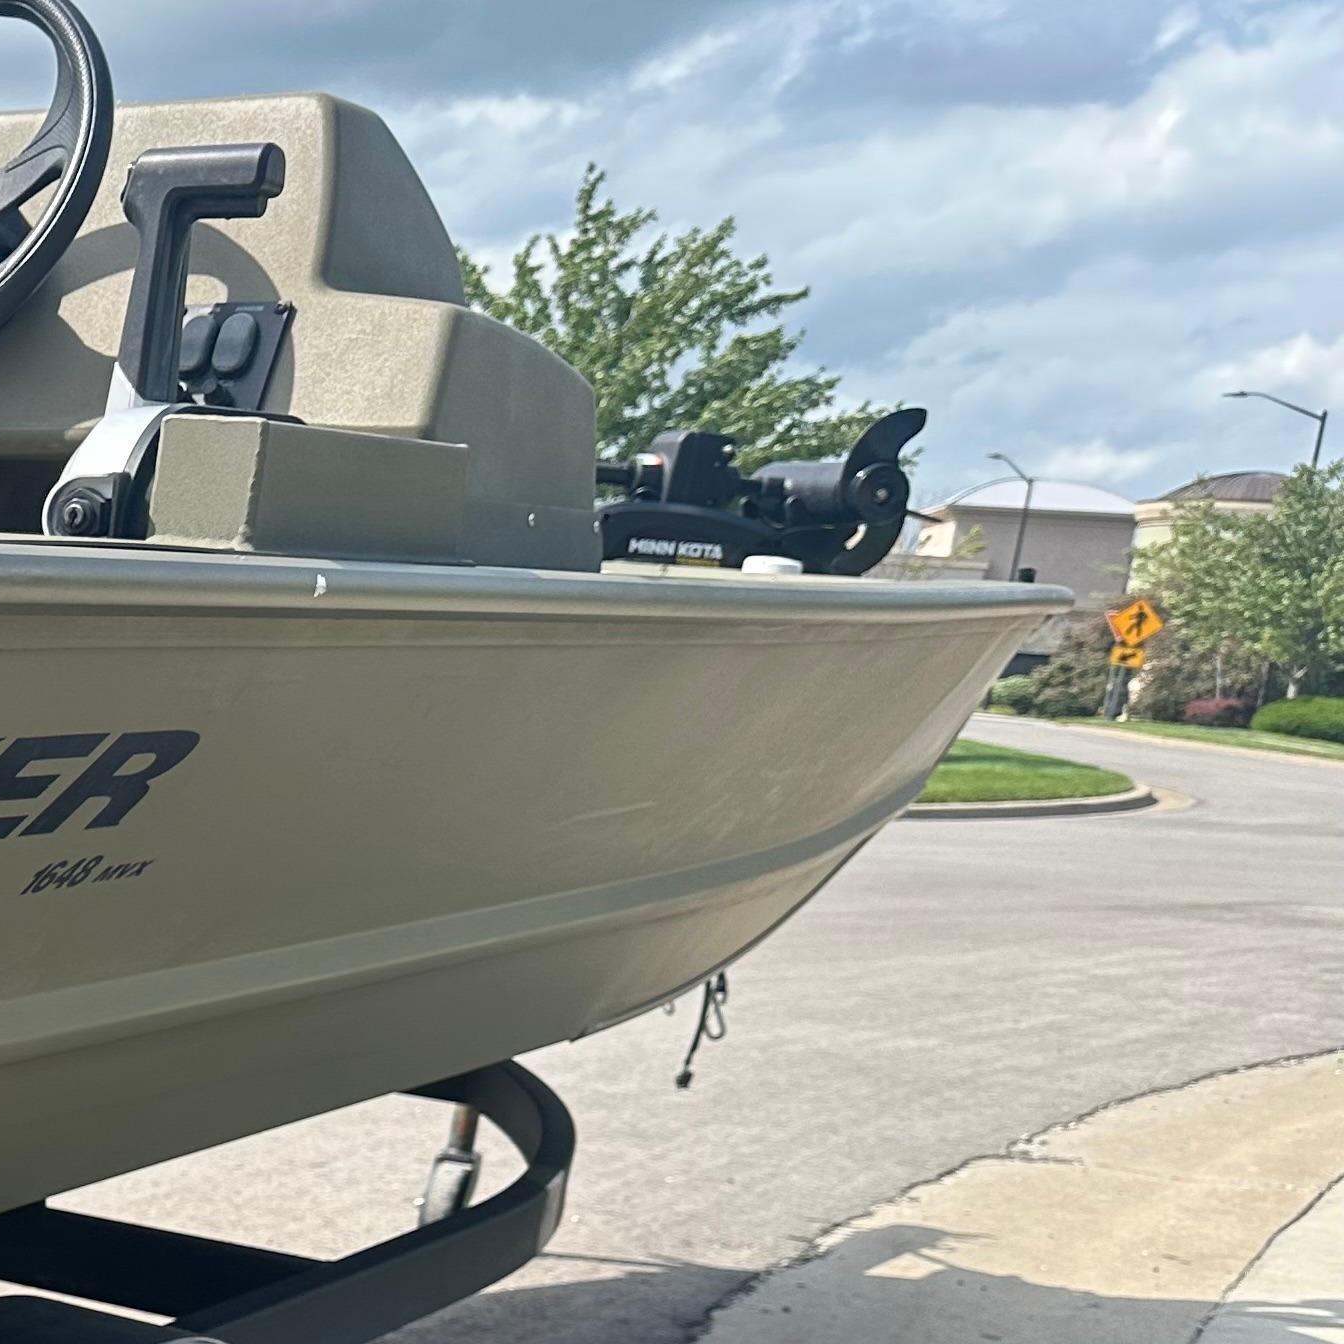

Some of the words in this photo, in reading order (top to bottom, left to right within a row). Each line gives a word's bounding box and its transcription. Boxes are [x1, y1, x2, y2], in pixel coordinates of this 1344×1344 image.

[627, 538, 676, 557] MINN
[676, 540, 724, 560] KOTA
[19, 854, 105, 896] 1648
[91, 858, 156, 884] MVX
